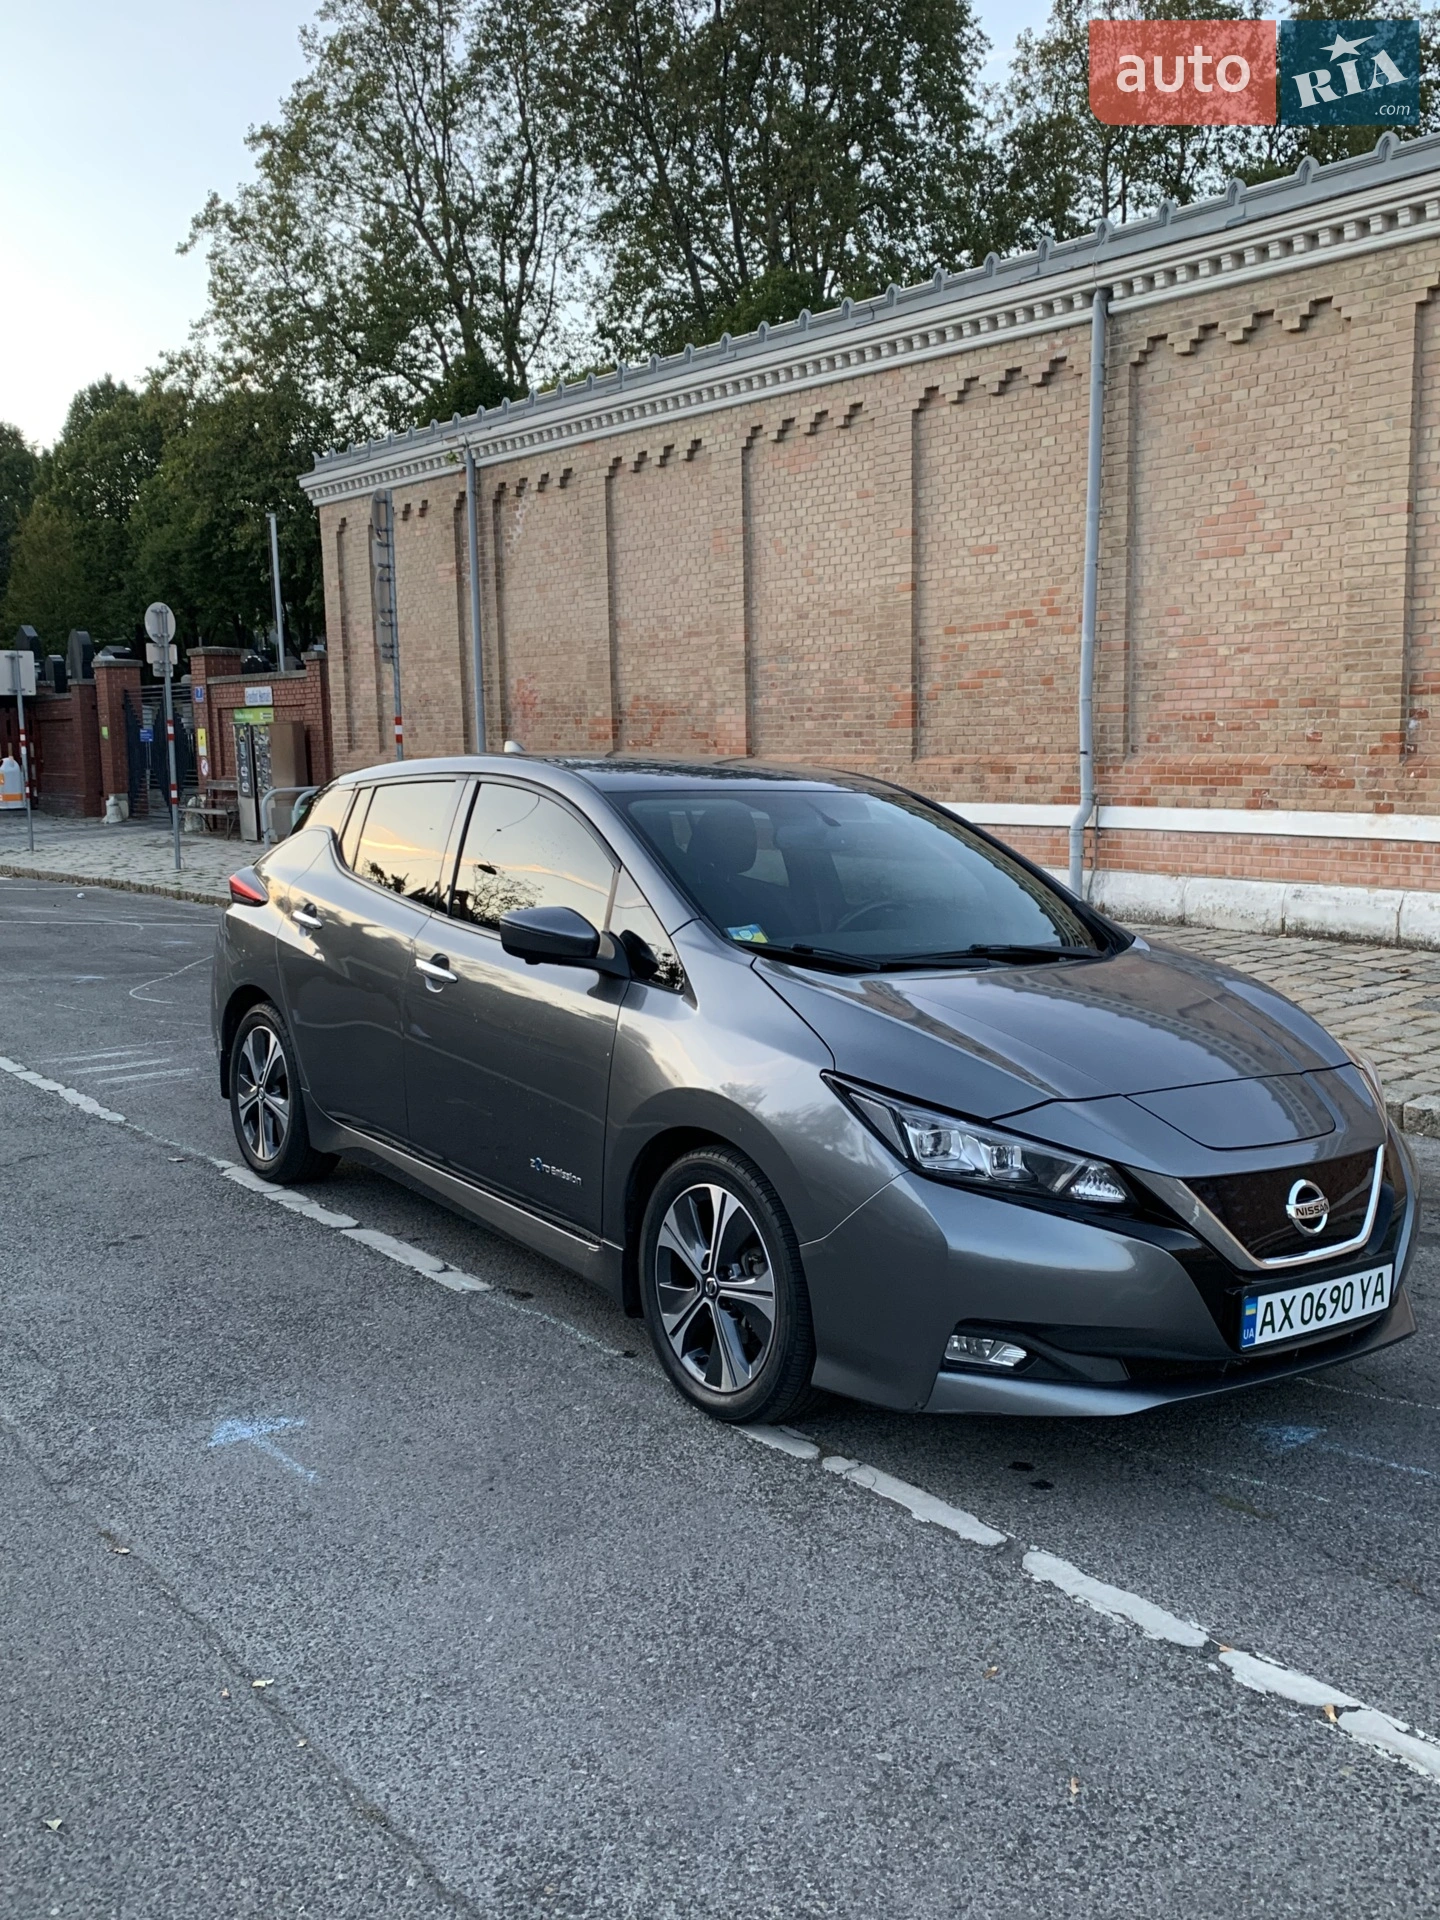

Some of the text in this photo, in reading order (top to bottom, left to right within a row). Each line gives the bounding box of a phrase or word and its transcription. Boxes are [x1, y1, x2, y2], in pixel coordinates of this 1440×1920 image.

[1295, 1202, 1330, 1217] NISSAN
[1259, 1271, 1385, 1337] AX 0690 YA
[1243, 1328, 1255, 1340] UA
